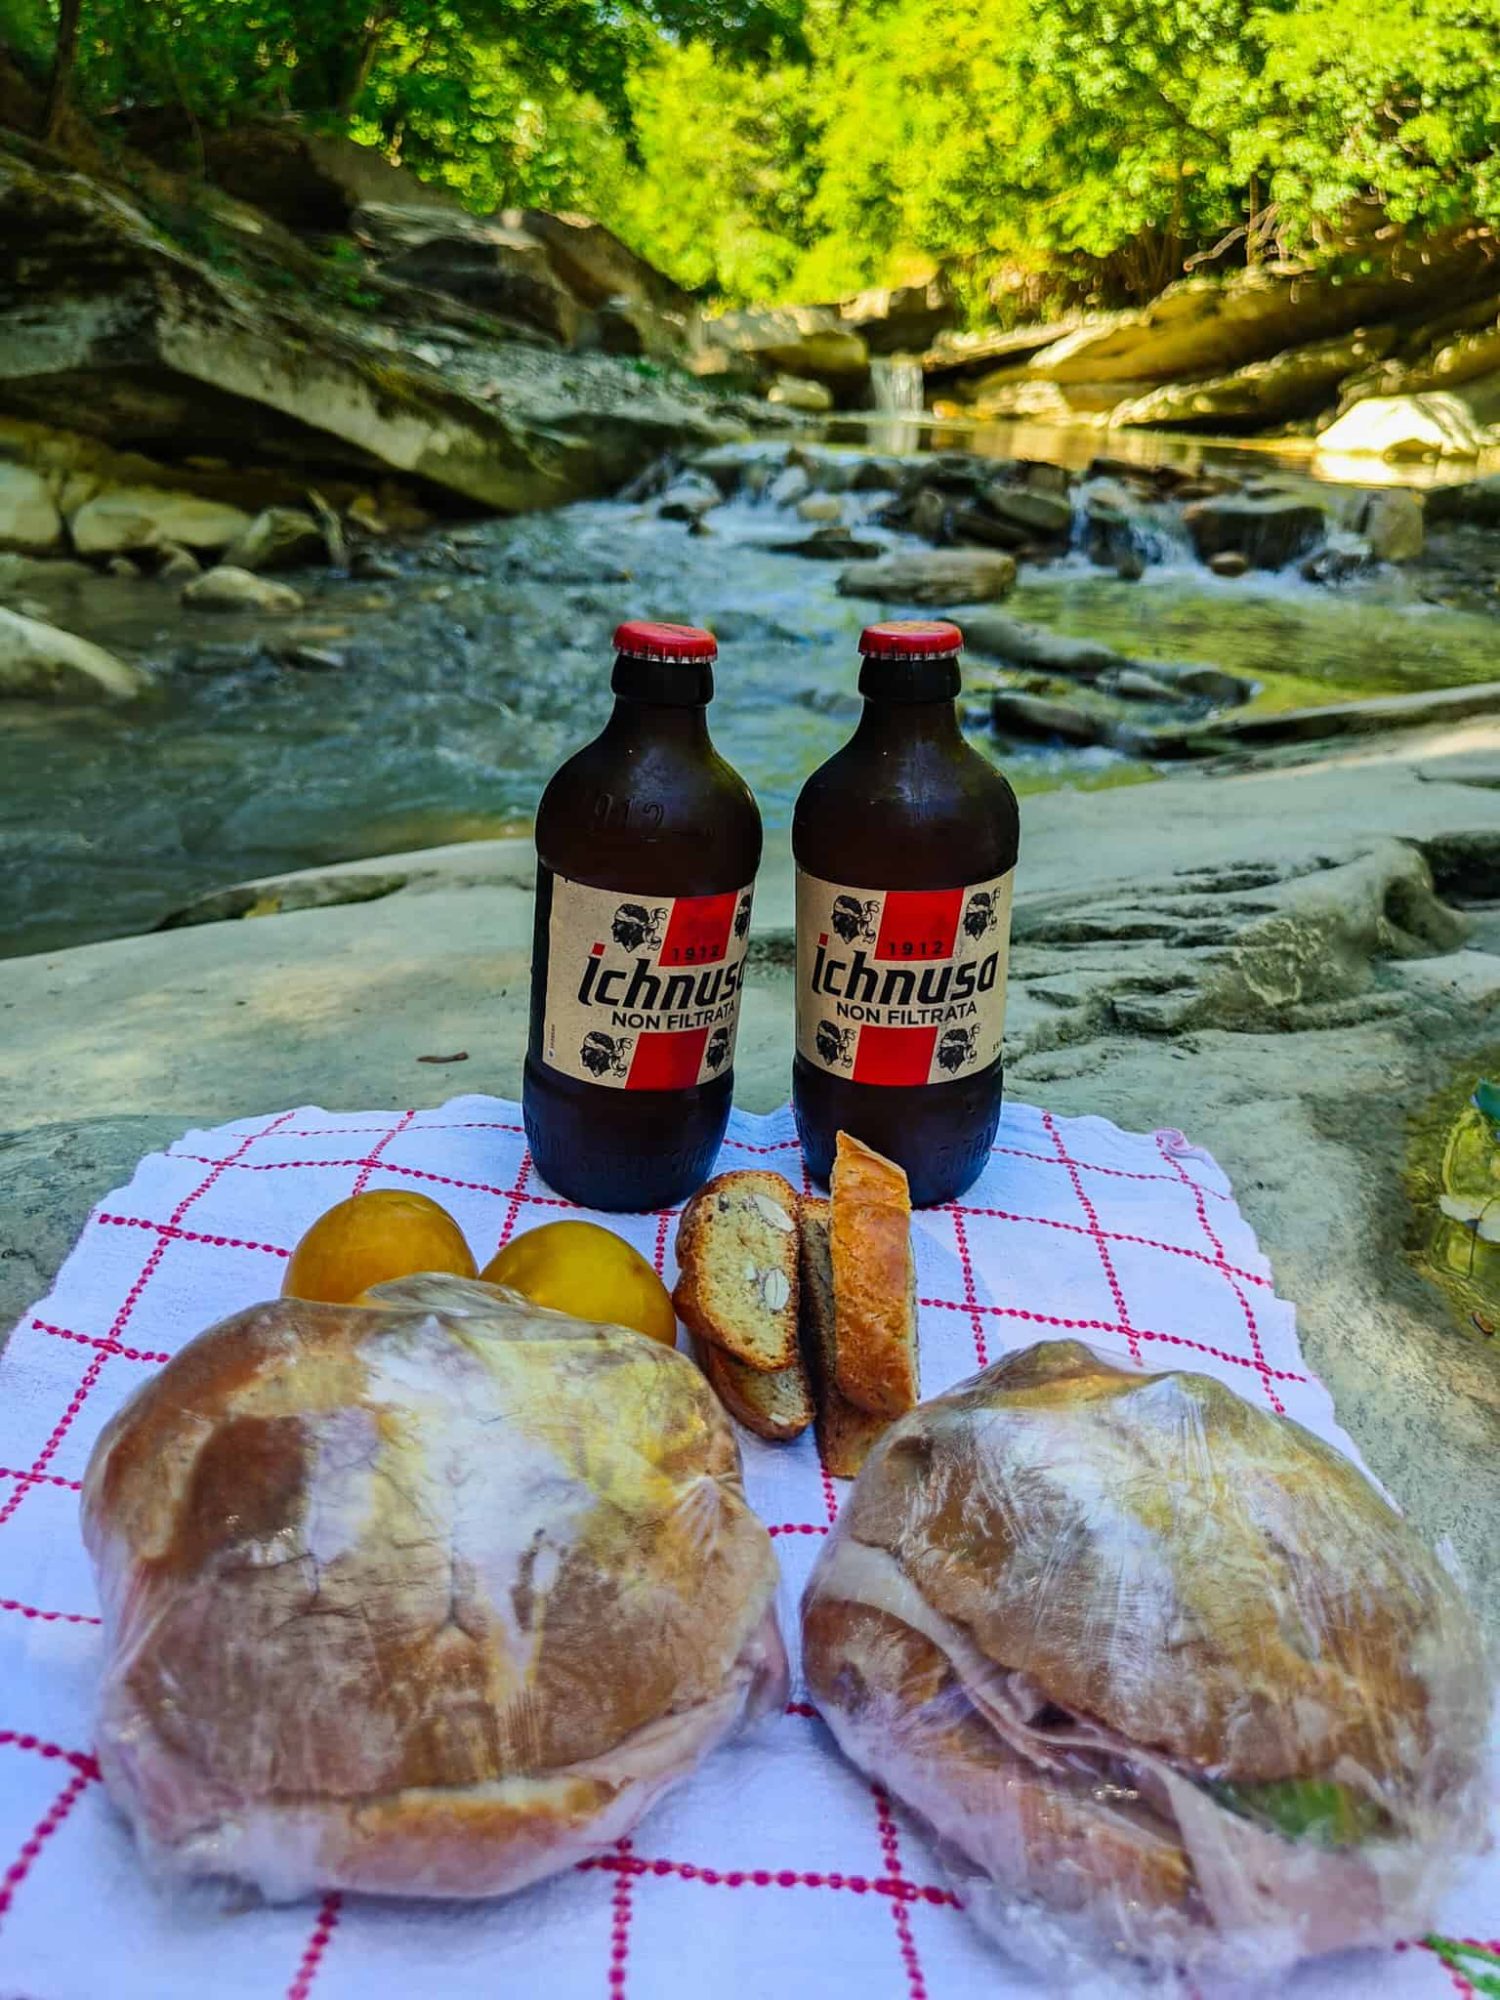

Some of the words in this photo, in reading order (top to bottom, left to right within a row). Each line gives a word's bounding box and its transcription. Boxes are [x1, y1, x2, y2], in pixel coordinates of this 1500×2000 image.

[671, 944, 720, 962] 1912
[889, 940, 944, 956] 1912
[811, 932, 999, 1006] ichnusa
[611, 1011, 660, 1030] NON
[667, 1000, 735, 1029] FILTRATA
[836, 1002, 880, 1024] NON
[887, 1001, 977, 1025] FILTRATA
